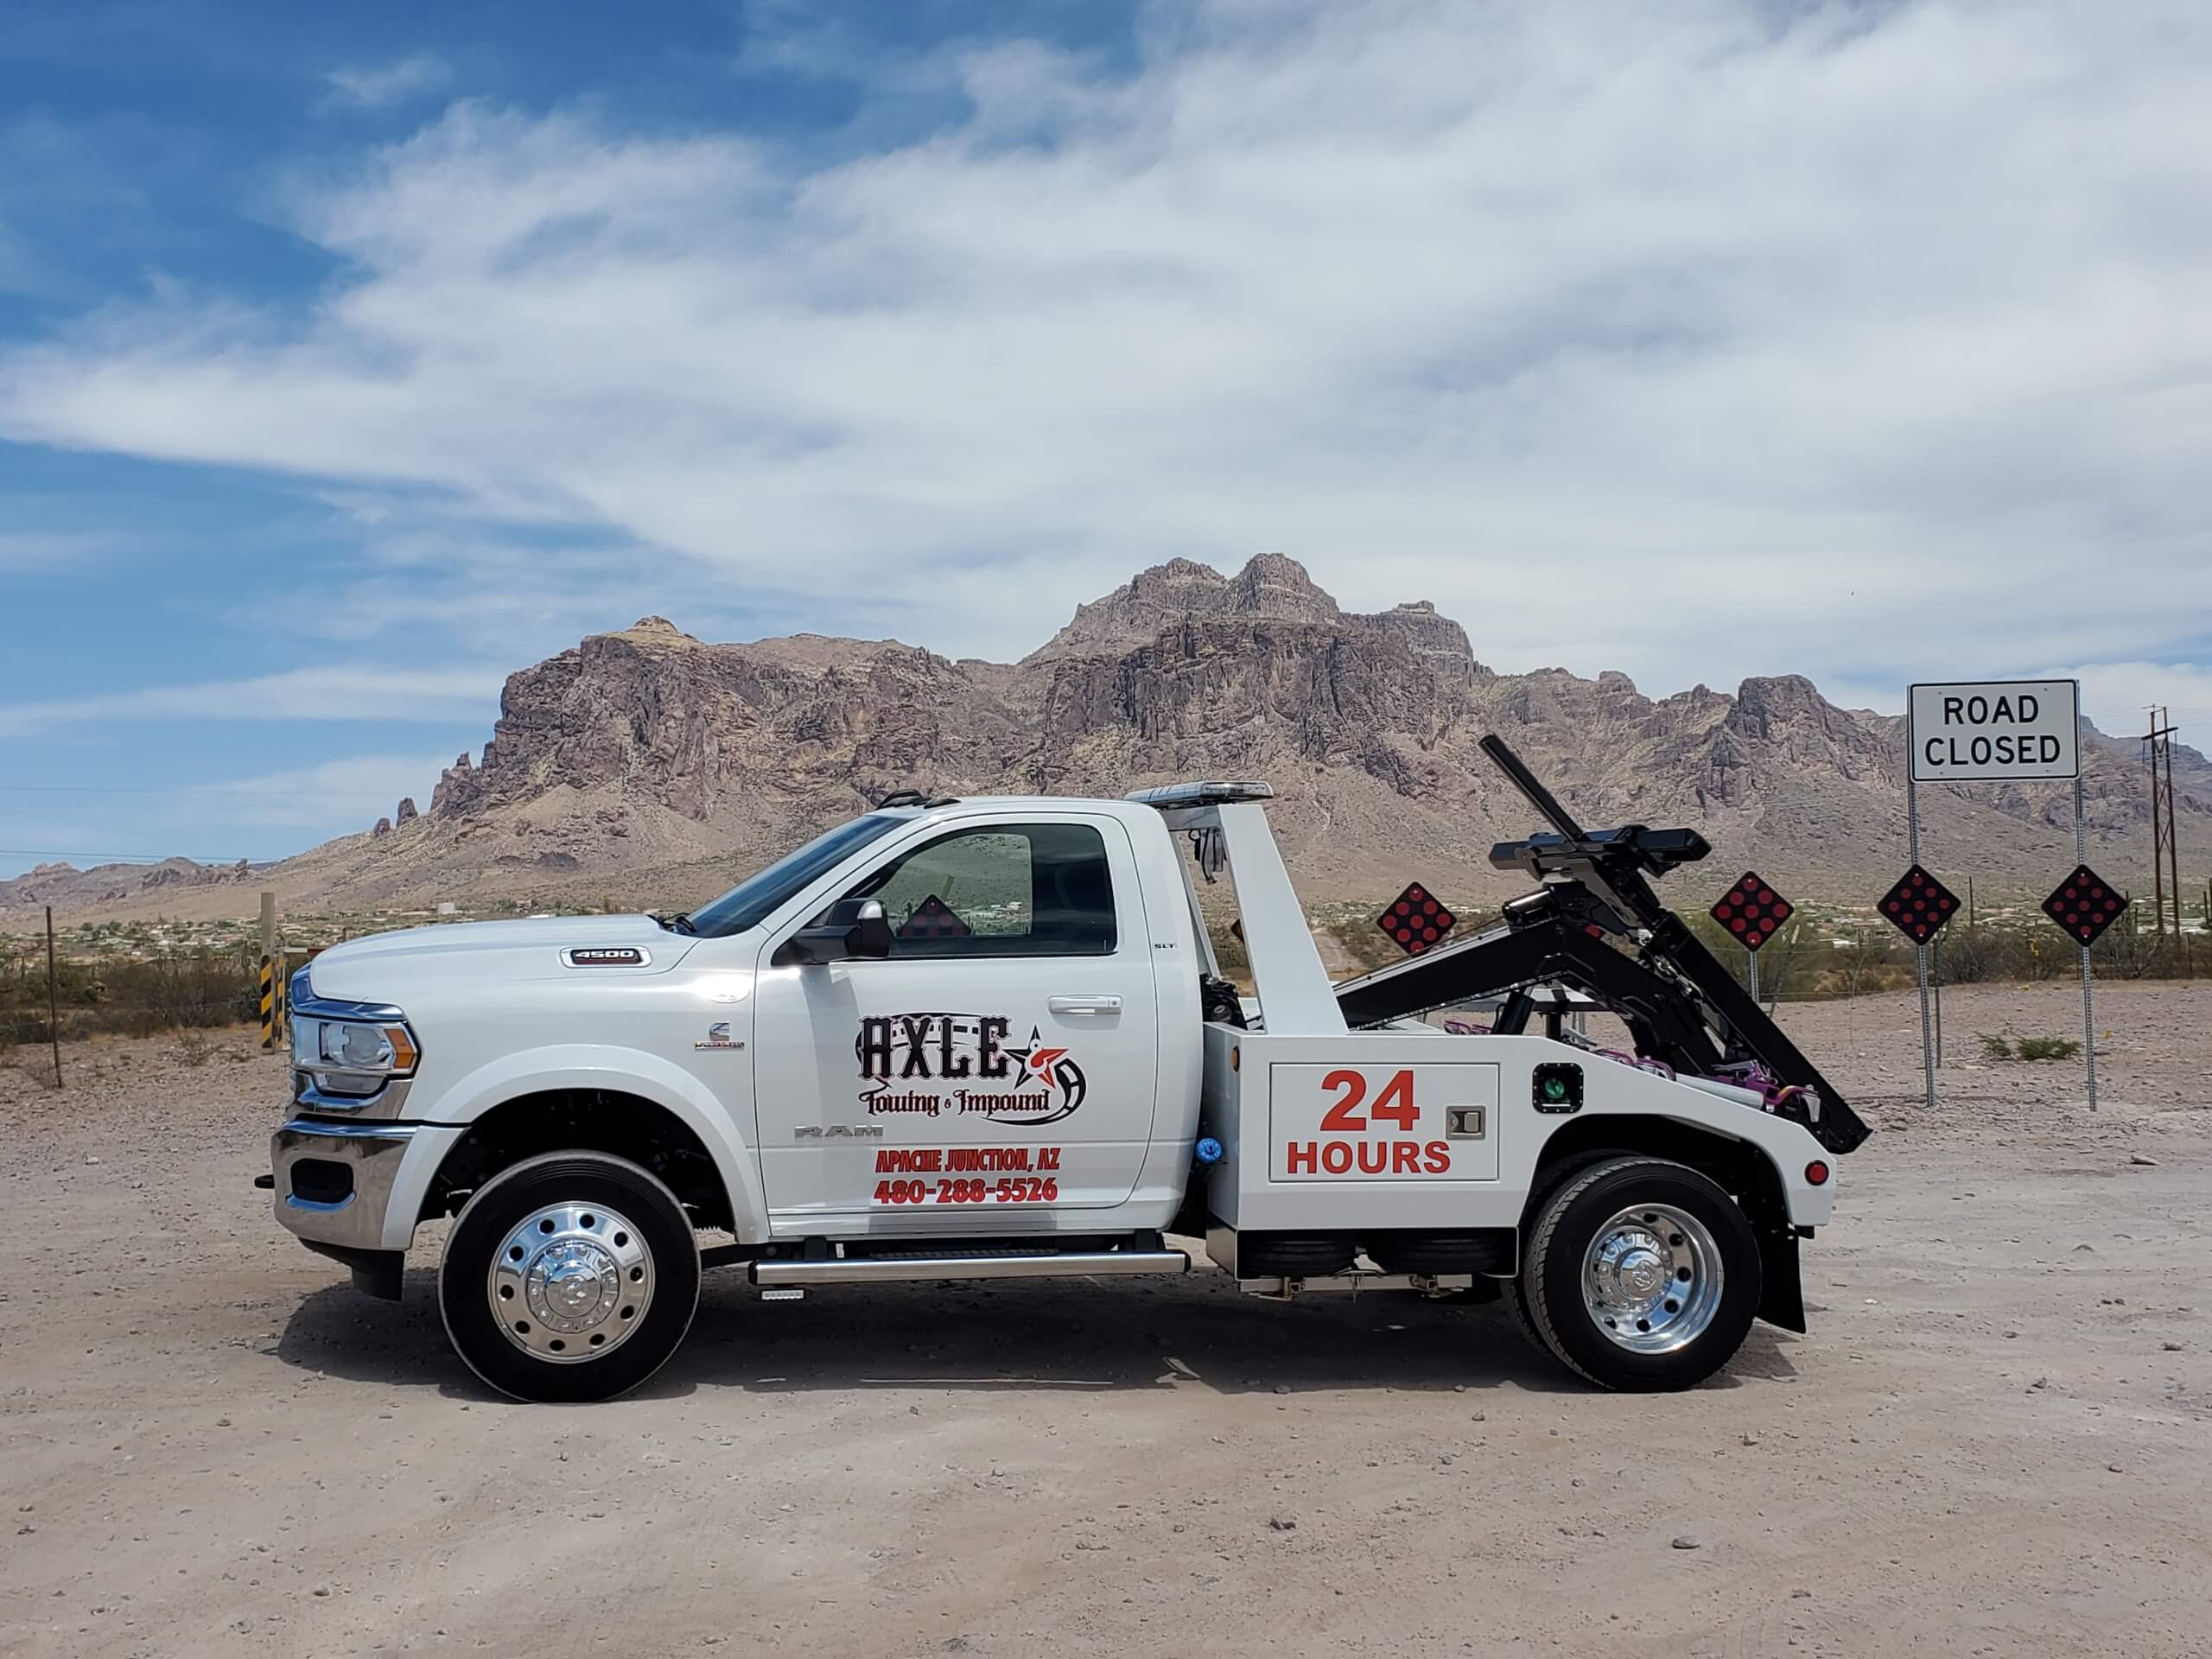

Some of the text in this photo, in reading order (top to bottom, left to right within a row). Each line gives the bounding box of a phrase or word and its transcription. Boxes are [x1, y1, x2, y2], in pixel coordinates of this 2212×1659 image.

[1943, 695, 2039, 725] ROAD
[1924, 734, 2061, 766] CLOSED
[575, 950, 635, 959] 4500
[860, 1016, 1011, 1079] AXLE
[859, 1086, 940, 1117] Towing
[952, 1090, 1051, 1117] Impound
[1319, 1070, 1420, 1131] 24
[794, 1124, 884, 1138] RAM
[875, 1147, 1060, 1173] APACHE JUNCTION, AZ
[1287, 1141, 1451, 1174] HOURS
[874, 1177, 1058, 1204] 480-288-5526
